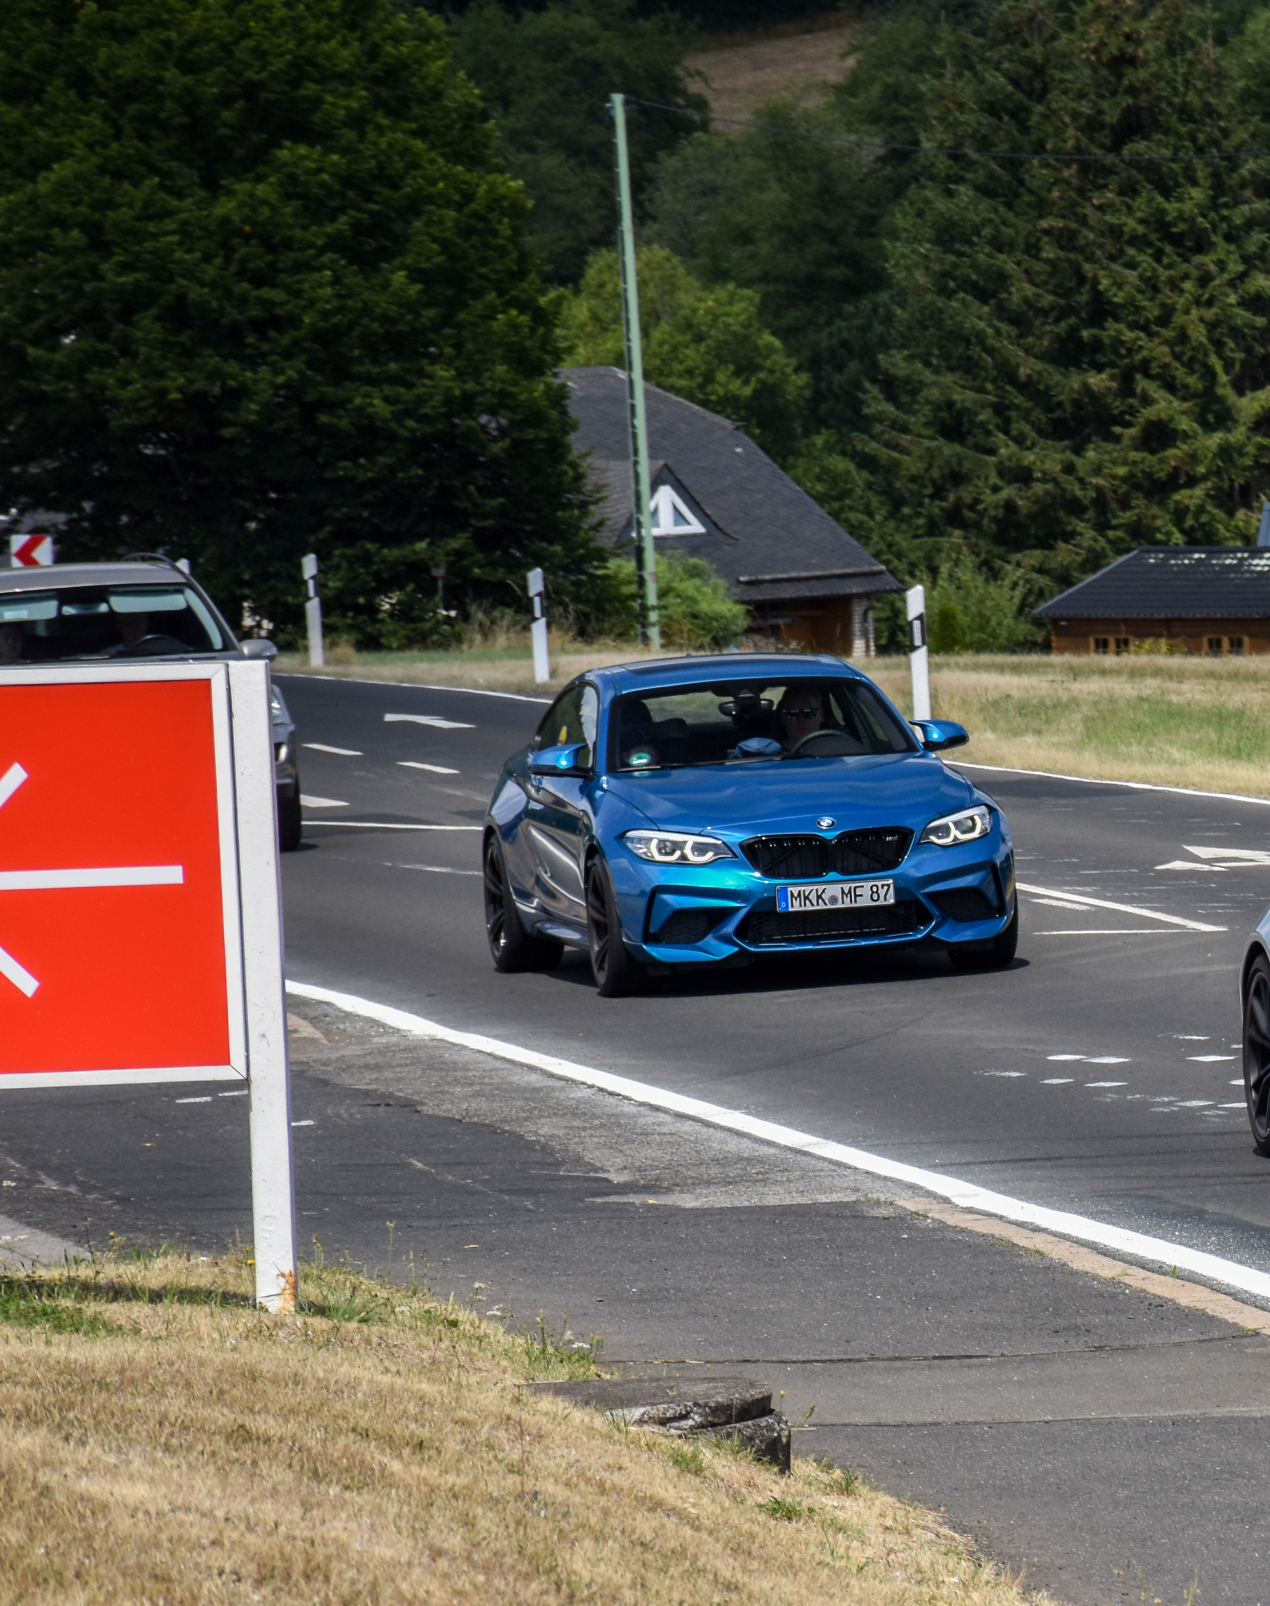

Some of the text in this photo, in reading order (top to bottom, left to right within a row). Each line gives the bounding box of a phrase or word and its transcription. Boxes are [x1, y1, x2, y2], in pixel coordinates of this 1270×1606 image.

[789, 884, 891, 908] MKK MF 87
